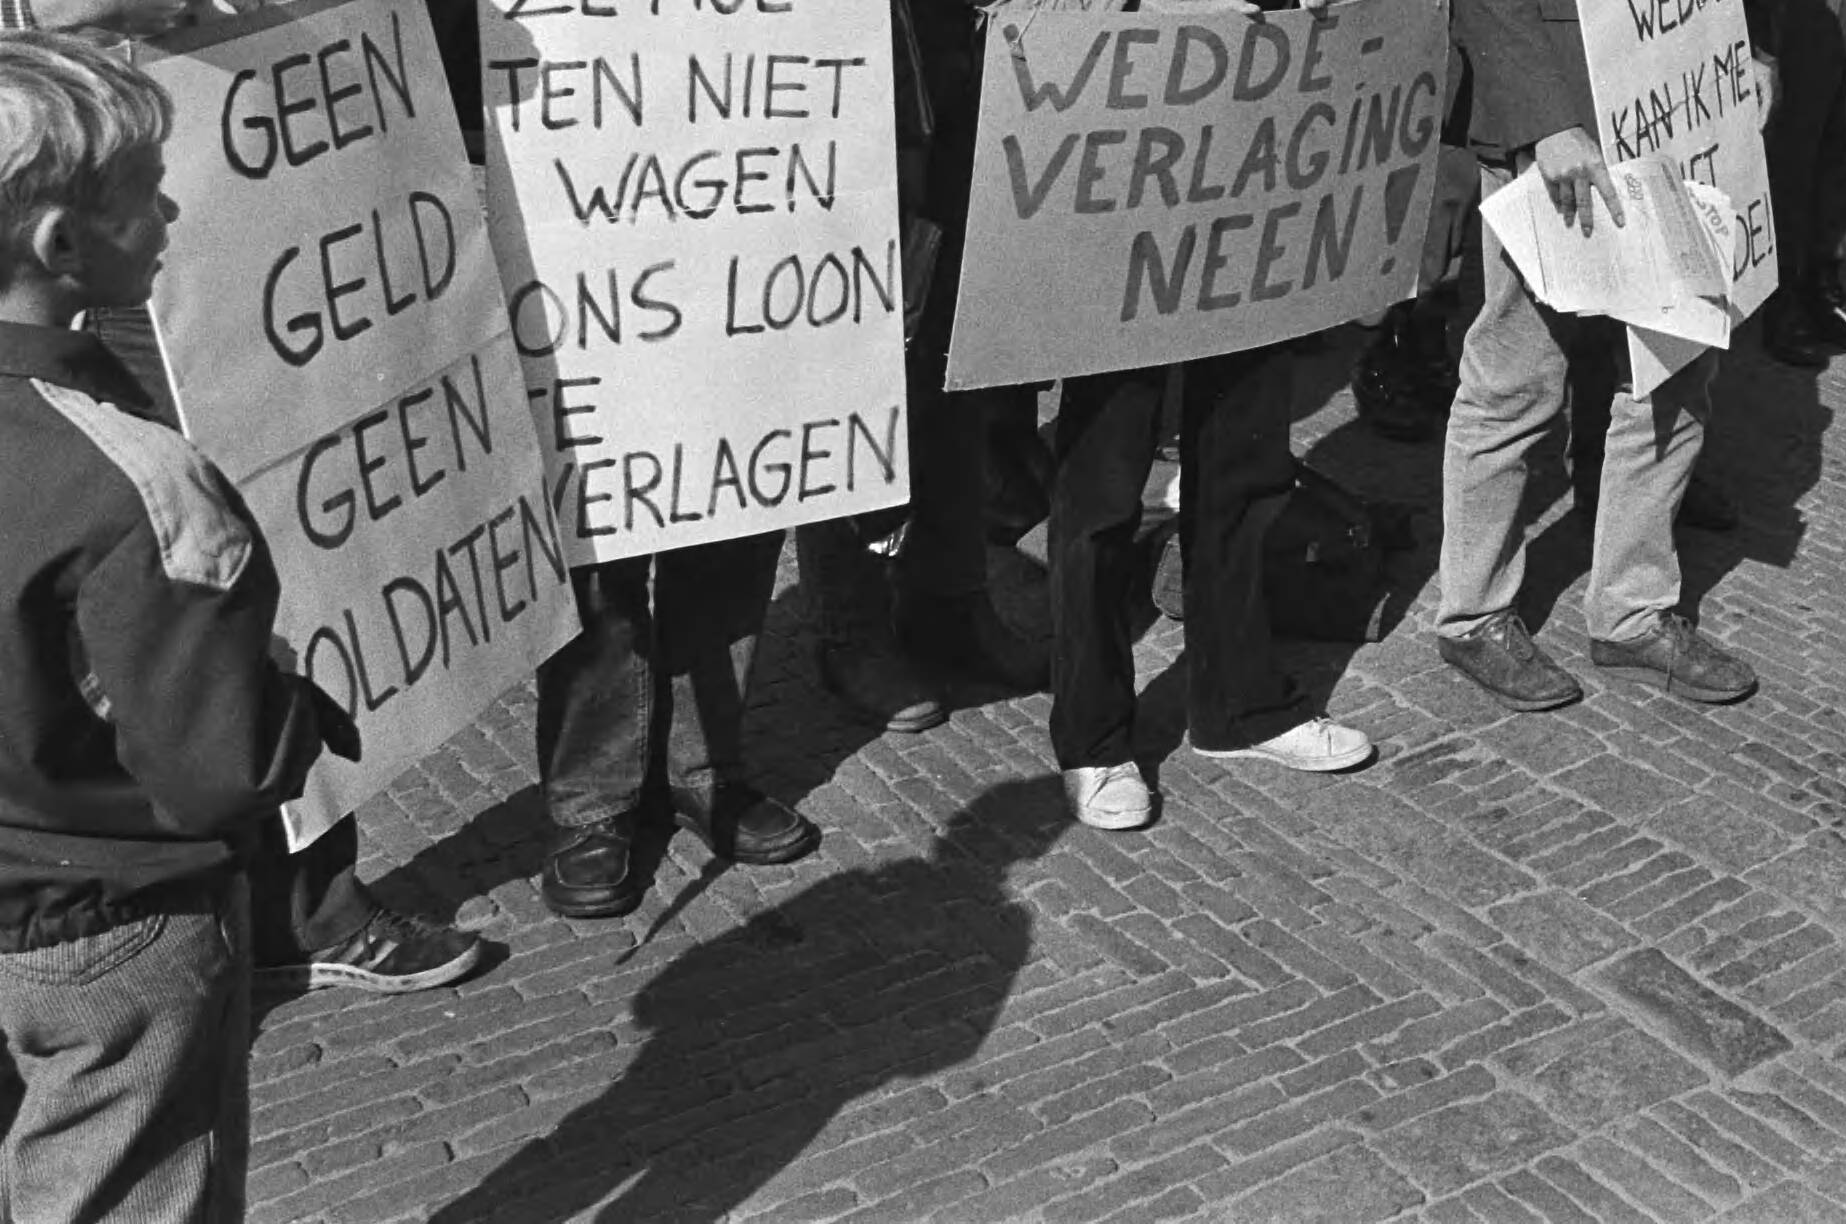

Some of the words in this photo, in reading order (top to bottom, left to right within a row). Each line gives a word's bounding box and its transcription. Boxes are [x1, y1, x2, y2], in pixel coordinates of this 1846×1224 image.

[221, 9, 416, 180] GEEN
[487, 52, 644, 133] TEN
[687, 52, 867, 123] NIET
[1611, 81, 1674, 163] KAN
[1682, 61, 1711, 132] IK
[554, 139, 837, 228] WAGEN
[262, 190, 456, 368] GELD
[510, 259, 682, 358] ONS
[726, 238, 896, 338] LOON
[296, 353, 493, 551] GEEN
[527, 375, 604, 454] E
[303, 470, 567, 728] OLDATEN
